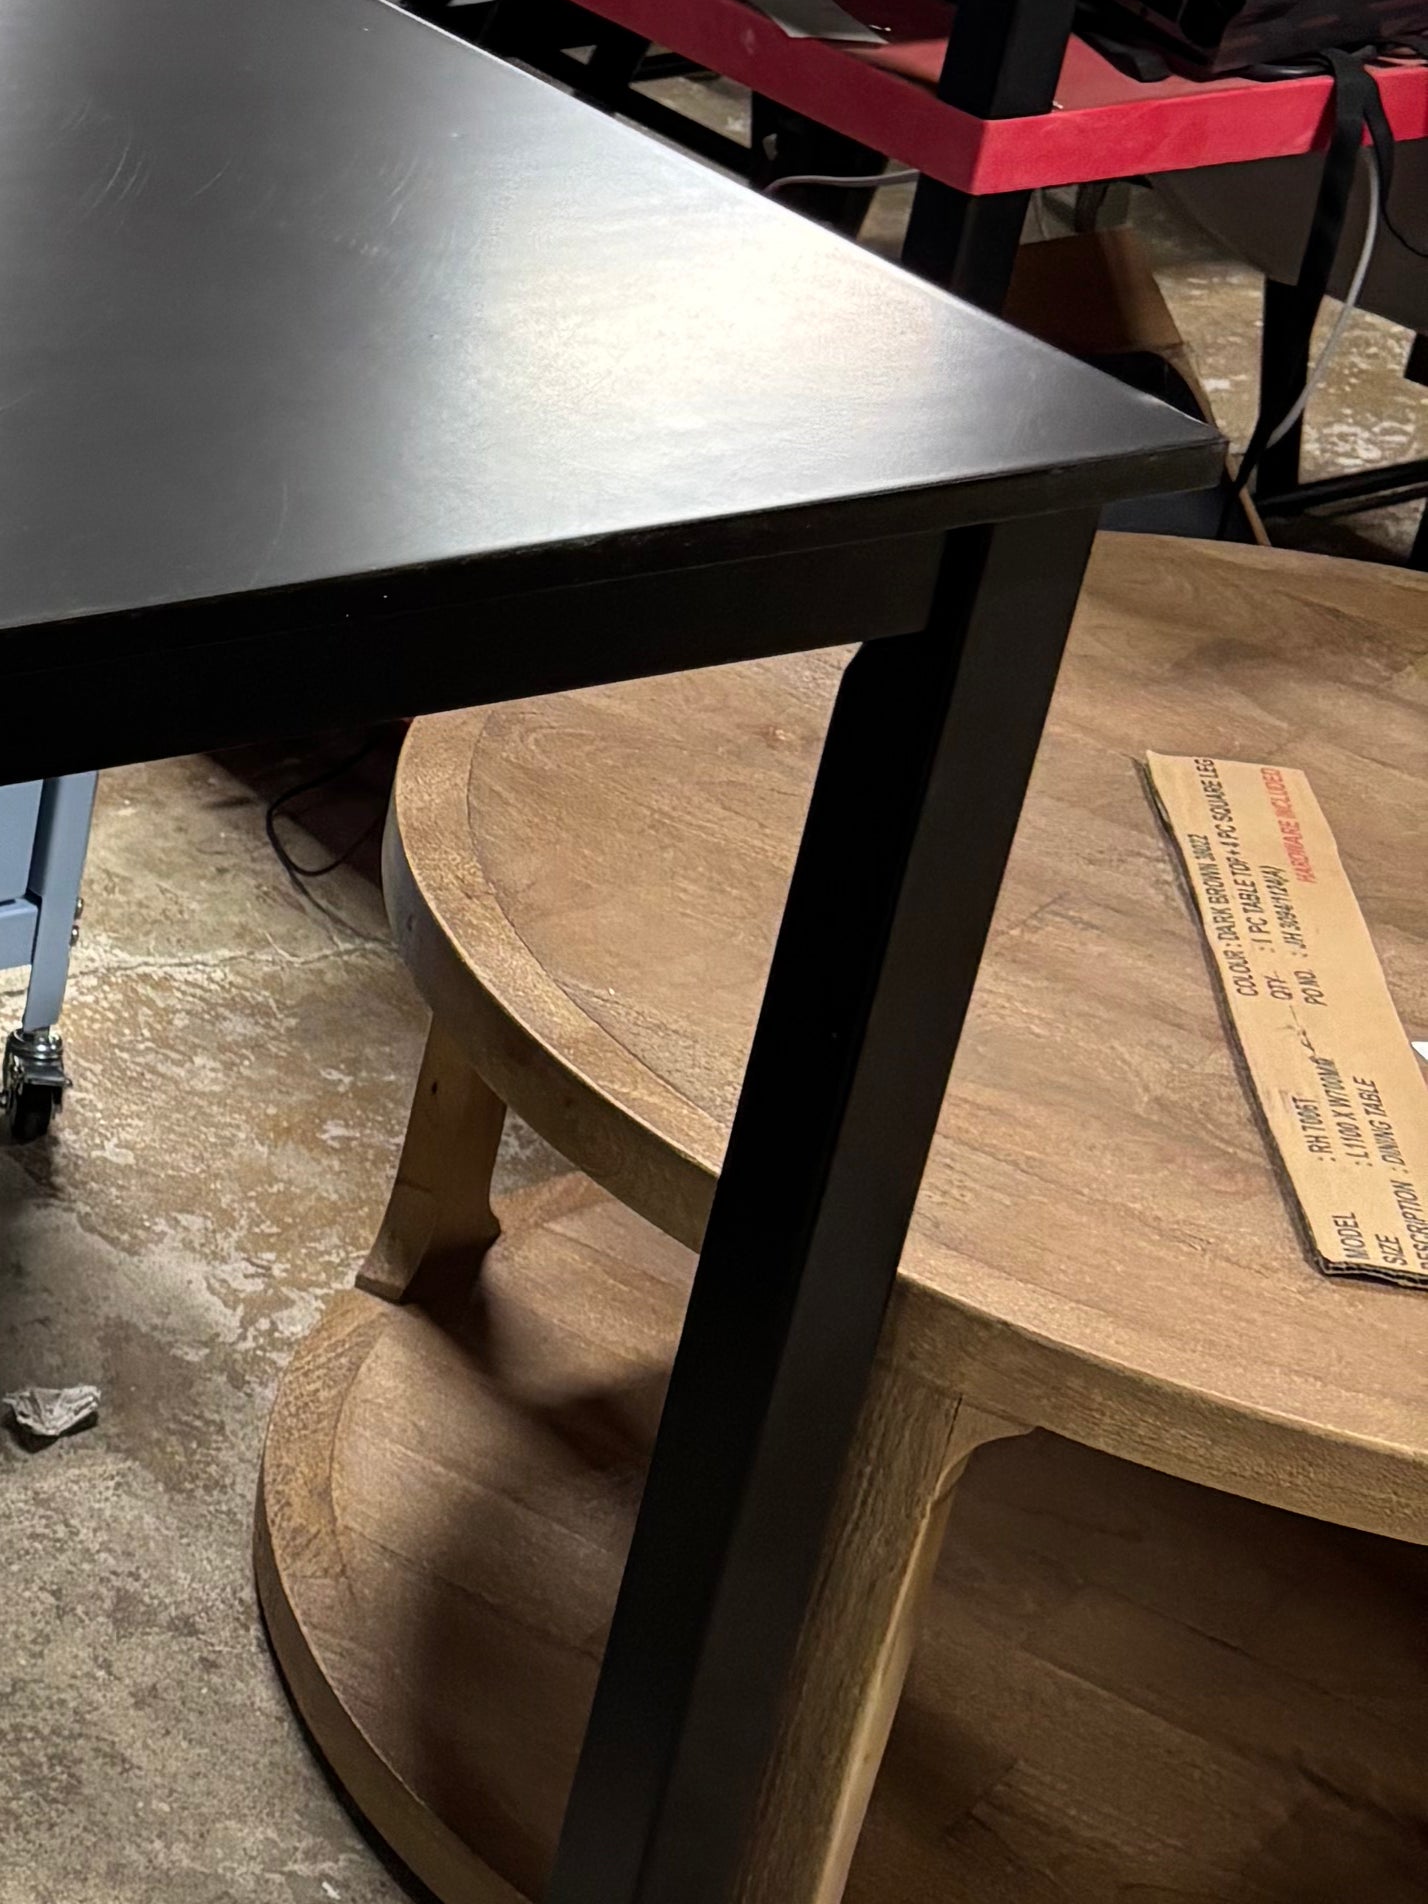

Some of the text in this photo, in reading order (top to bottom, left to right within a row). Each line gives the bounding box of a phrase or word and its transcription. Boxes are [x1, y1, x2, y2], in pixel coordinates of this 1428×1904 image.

[1193, 758, 1219, 779] LEG
[1201, 778, 1234, 823] SQUARE
[1214, 822, 1239, 842] PC
[1260, 766, 1318, 885] HARDWARE INCLUDED
[1197, 862, 1230, 905] BROWN
[1225, 856, 1252, 877] TOP
[1233, 878, 1266, 914] TABLE
[1209, 906, 1241, 942] DARK
[1245, 915, 1272, 935] PC
[1222, 949, 1259, 997] COLOUR
[1263, 974, 1294, 1001] QTY
[1352, 1075, 1388, 1118] TABLE
[1330, 1108, 1358, 1122] X
[1304, 1134, 1334, 1155] RH
[1368, 1119, 1406, 1167] DINING
[1331, 1211, 1370, 1260] MODEL
[1374, 1233, 1409, 1266] SIZE
